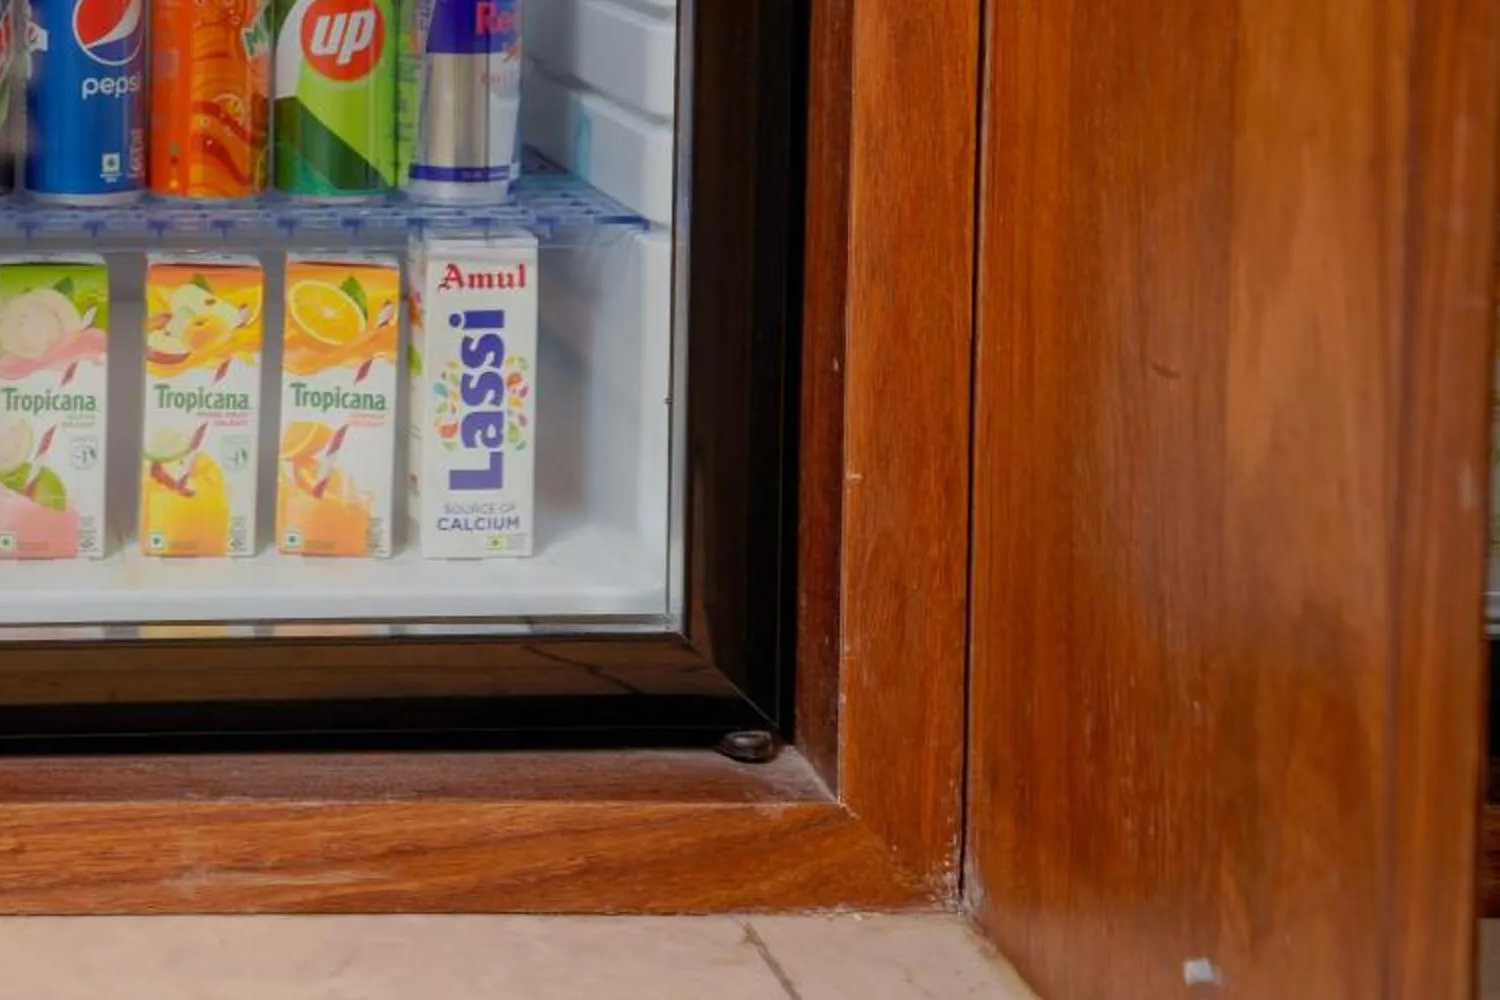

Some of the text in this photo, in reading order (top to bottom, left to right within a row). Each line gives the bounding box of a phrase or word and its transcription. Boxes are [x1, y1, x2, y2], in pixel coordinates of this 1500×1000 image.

[437, 262, 527, 292] Amul
[0, 387, 97, 416] Tropicana
[153, 384, 250, 414] Tropicana
[289, 382, 387, 414] Tropicana
[448, 309, 506, 490] Lassi
[436, 516, 521, 531] CALCIUM
